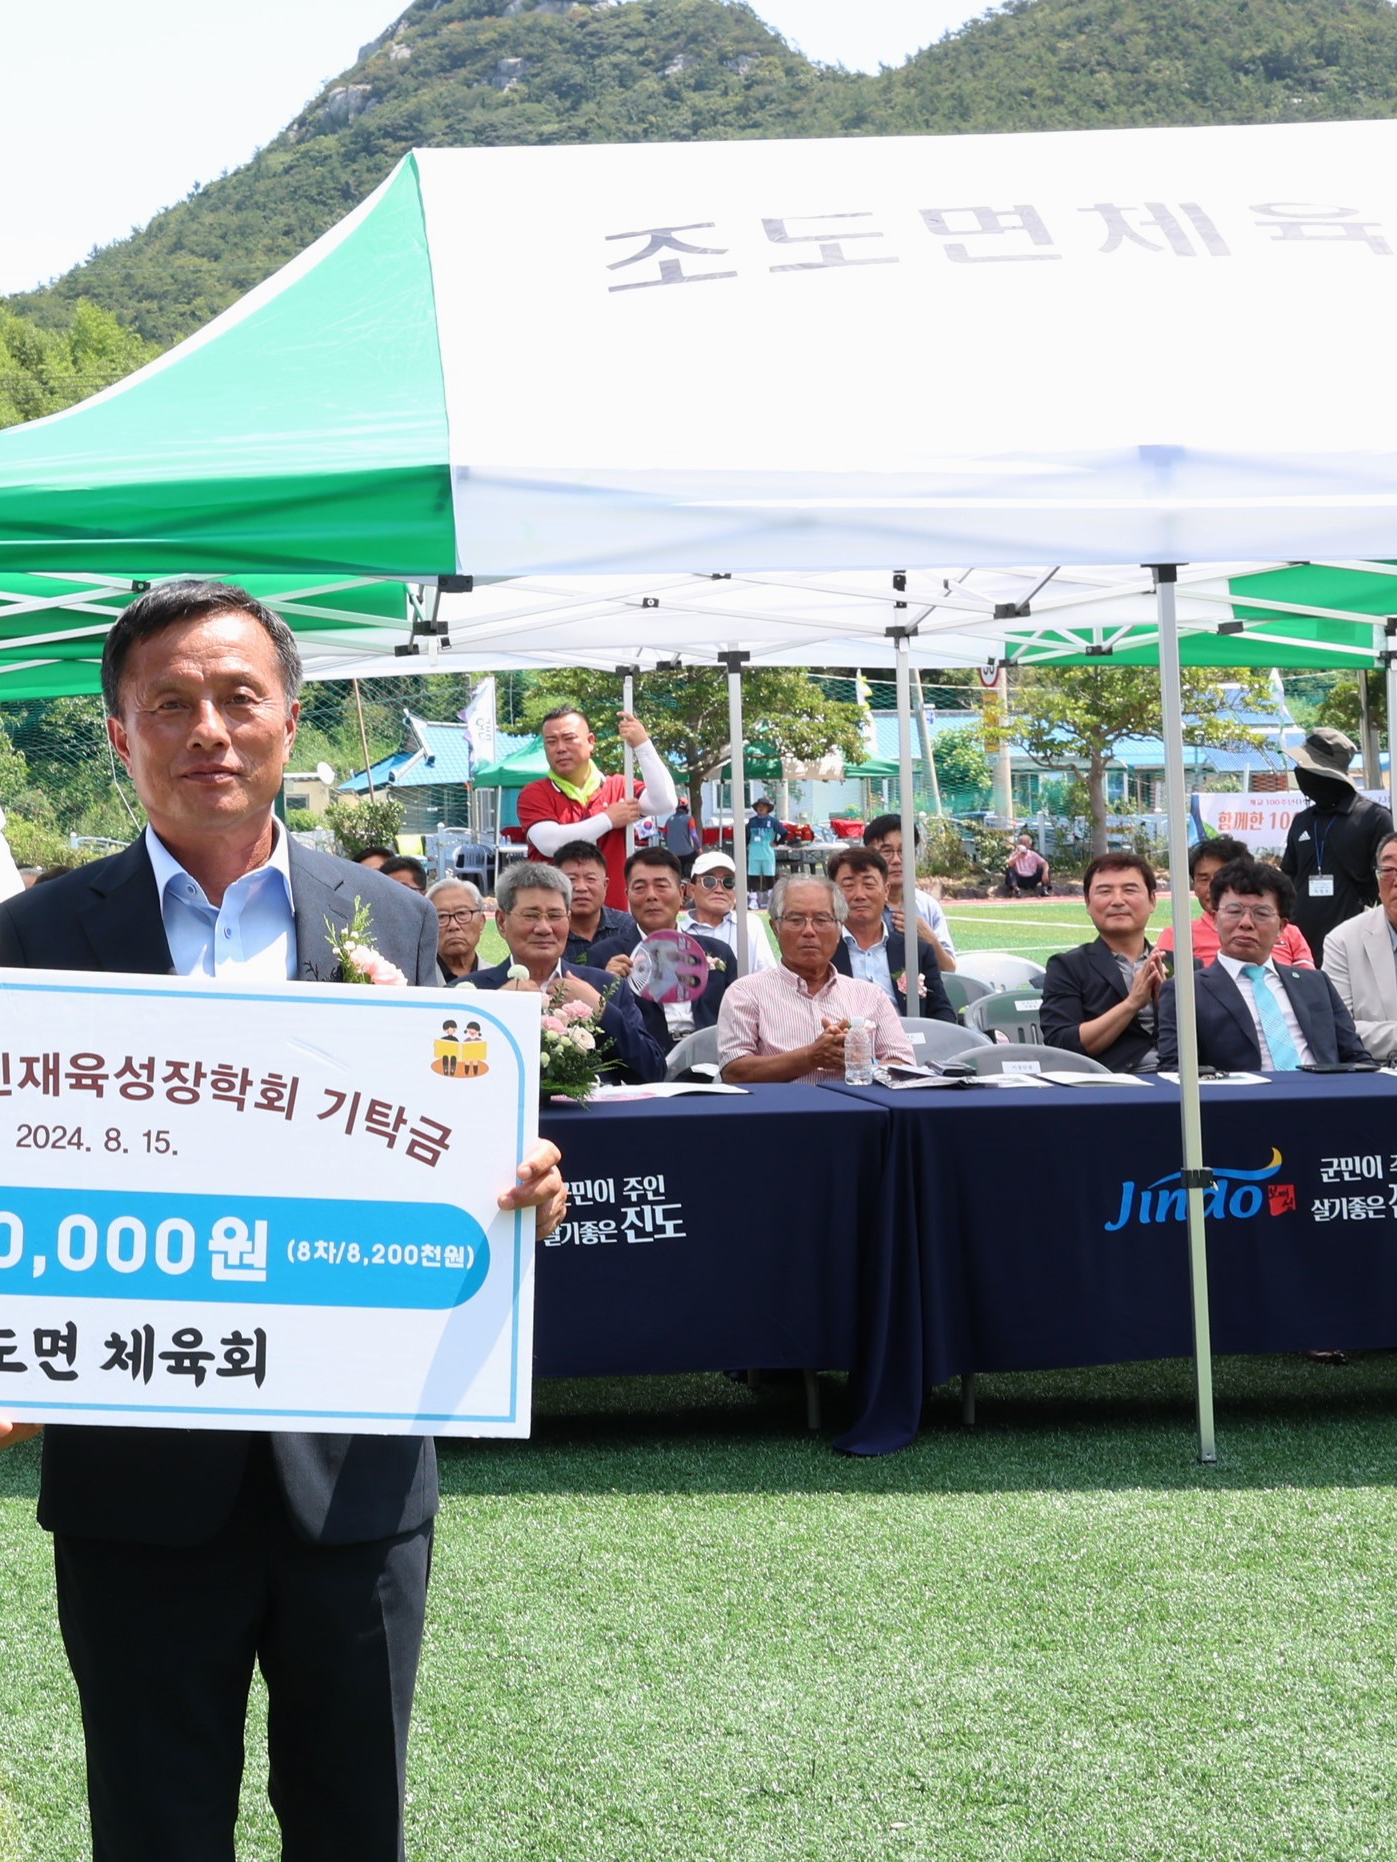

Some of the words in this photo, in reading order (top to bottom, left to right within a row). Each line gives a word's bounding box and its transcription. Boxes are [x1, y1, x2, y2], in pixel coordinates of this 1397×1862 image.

[1217, 811, 1265, 831] 함께한
[15, 1123, 93, 1154] 2024.
[103, 1126, 130, 1155] 8.
[141, 1129, 179, 1156] 15.
[315, 1086, 453, 1169] 기탁금
[1320, 1155, 1384, 1183] 군민이
[623, 1174, 666, 1202] 주인
[620, 1203, 687, 1244] 진도
[1311, 1195, 1385, 1222] 살기좋은
[286, 1239, 476, 1271] (8차/8,200천원)
[100, 1325, 270, 1388] 체육회
